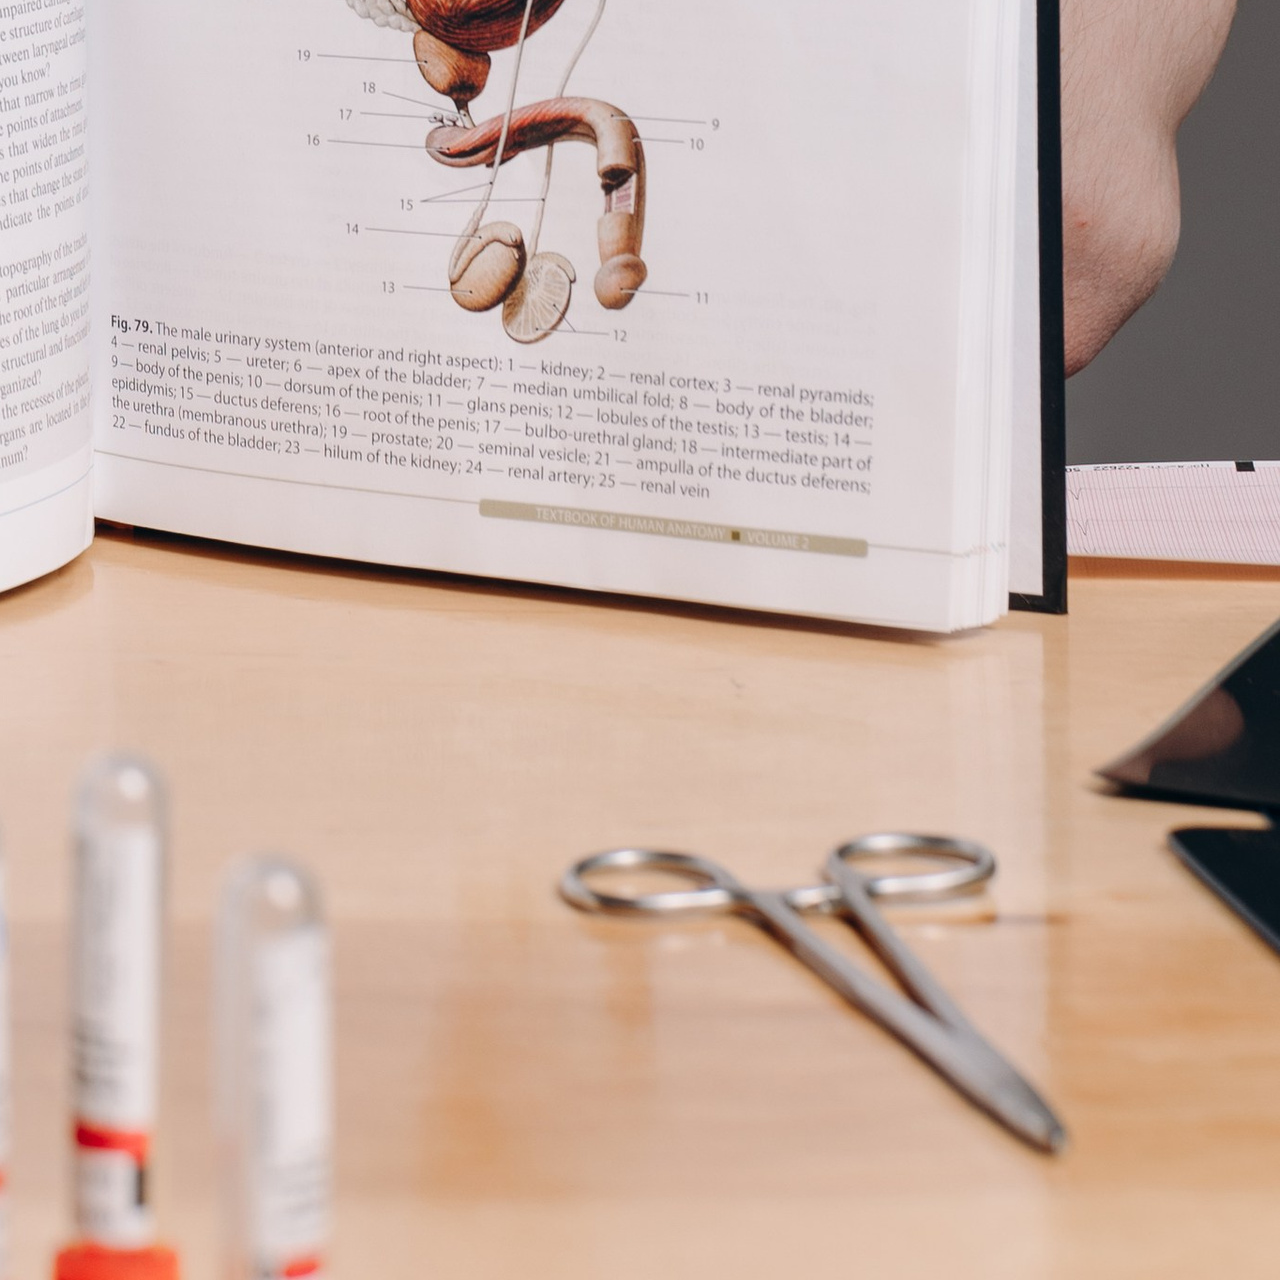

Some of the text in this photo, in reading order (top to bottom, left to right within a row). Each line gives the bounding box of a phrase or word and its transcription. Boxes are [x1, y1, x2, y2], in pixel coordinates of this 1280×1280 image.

[298, 50, 310, 61] 19
[363, 82, 375, 93] 18
[340, 109, 352, 120] 17
[712, 118, 720, 130] 9
[307, 134, 320, 146] 16
[691, 138, 704, 150] 10
[401, 199, 413, 211] 15
[347, 223, 358, 234] 14
[383, 281, 394, 293] 13
[697, 292, 708, 304] 11
[614, 330, 627, 342] 12
[112, 315, 131, 333] Fig.
[135, 319, 153, 332] 79.
[156, 321, 177, 337] The
[182, 327, 211, 341] male
[216, 333, 260, 350] urinary
[265, 338, 310, 352] system
[316, 341, 372, 358] (anterior
[378, 348, 403, 361] and
[409, 351, 440, 366] right
[446, 356, 503, 371] aspect):
[510, 359, 512, 371] 1
[542, 360, 592, 381] kidney;
[597, 366, 604, 380] 2
[631, 372, 664, 385] renal
[670, 377, 718, 391] cortex;
[724, 378, 731, 392] 3
[758, 384, 794, 397] renal
[800, 389, 873, 406] pyramids;
[536, 506, 809, 551] TEXTBOOK OF HUMAN ANATOMY VOLUME 2
